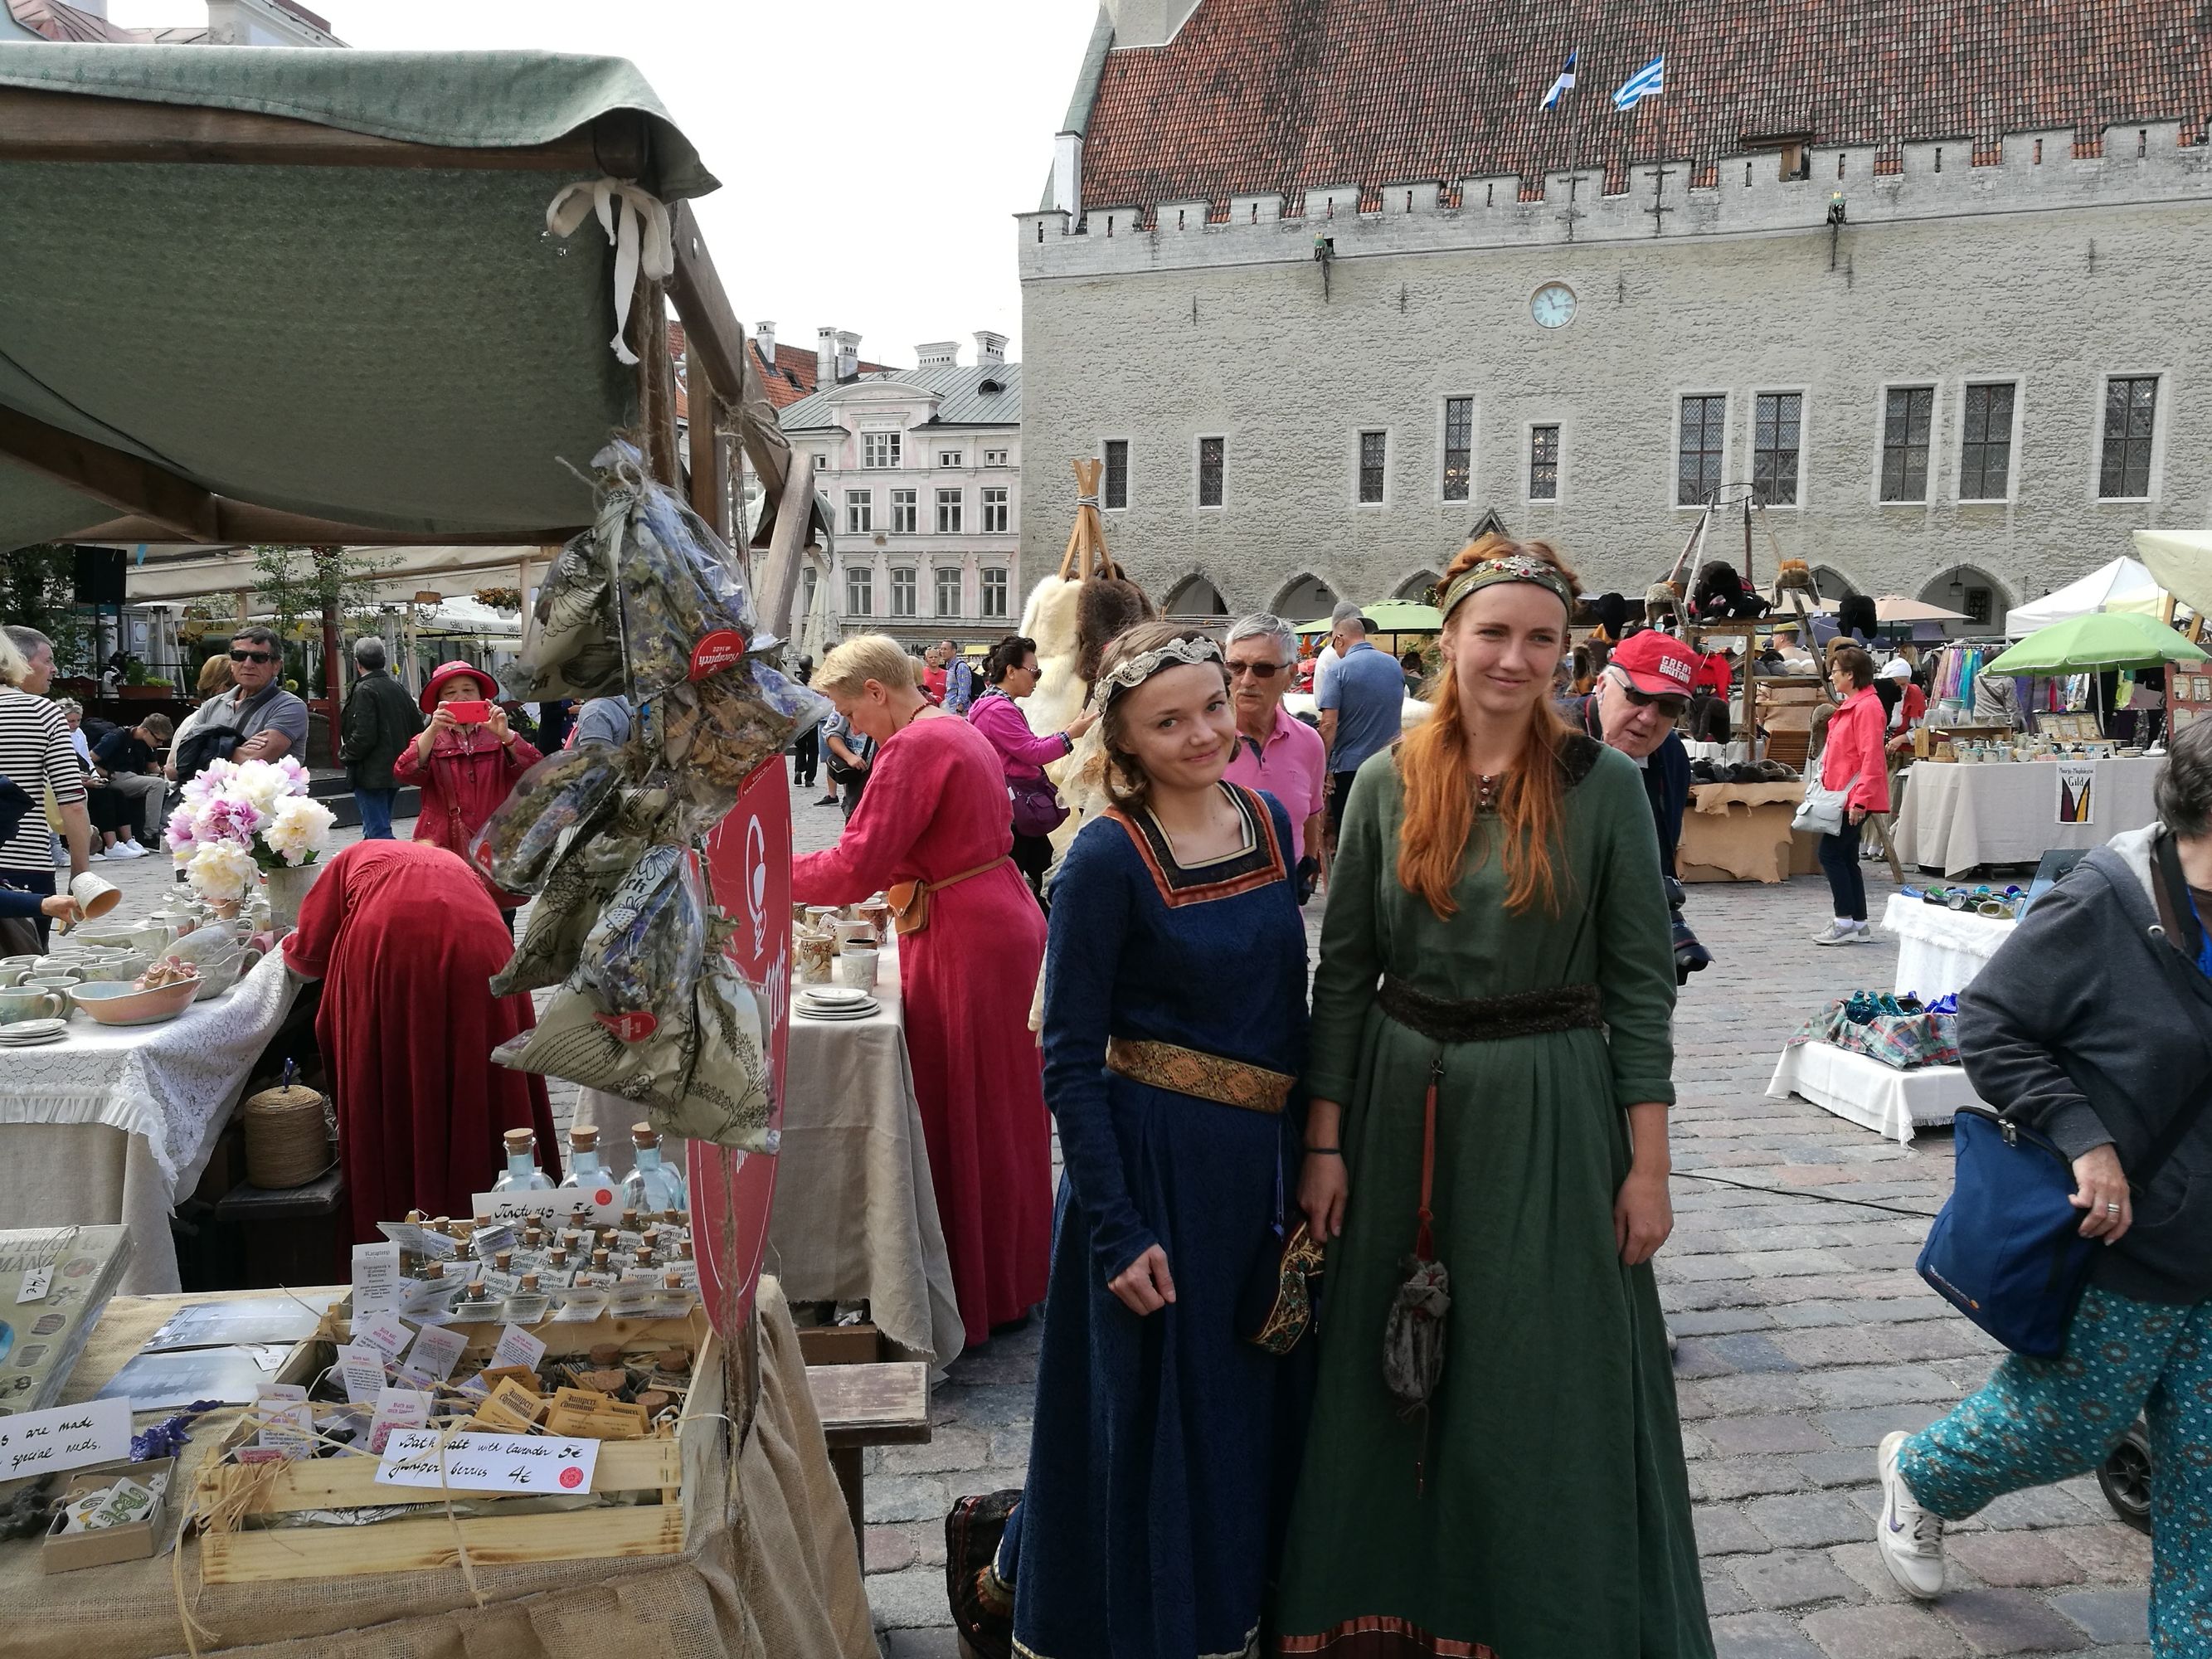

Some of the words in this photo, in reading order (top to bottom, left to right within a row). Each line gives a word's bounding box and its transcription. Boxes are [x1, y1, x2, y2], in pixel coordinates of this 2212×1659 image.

[1659, 664, 1691, 684] BRITAIN
[1661, 655, 1692, 674] GREAT
[2068, 776, 2083, 786] Gild
[26, 1427, 51, 1439] are
[58, 1416, 94, 1433] made
[399, 1433, 436, 1449] Bath
[478, 1443, 503, 1452] with
[506, 1443, 553, 1457] lavender
[12, 1447, 56, 1472] special
[450, 1462, 488, 1477] berries
[508, 1466, 531, 1484] 4€
